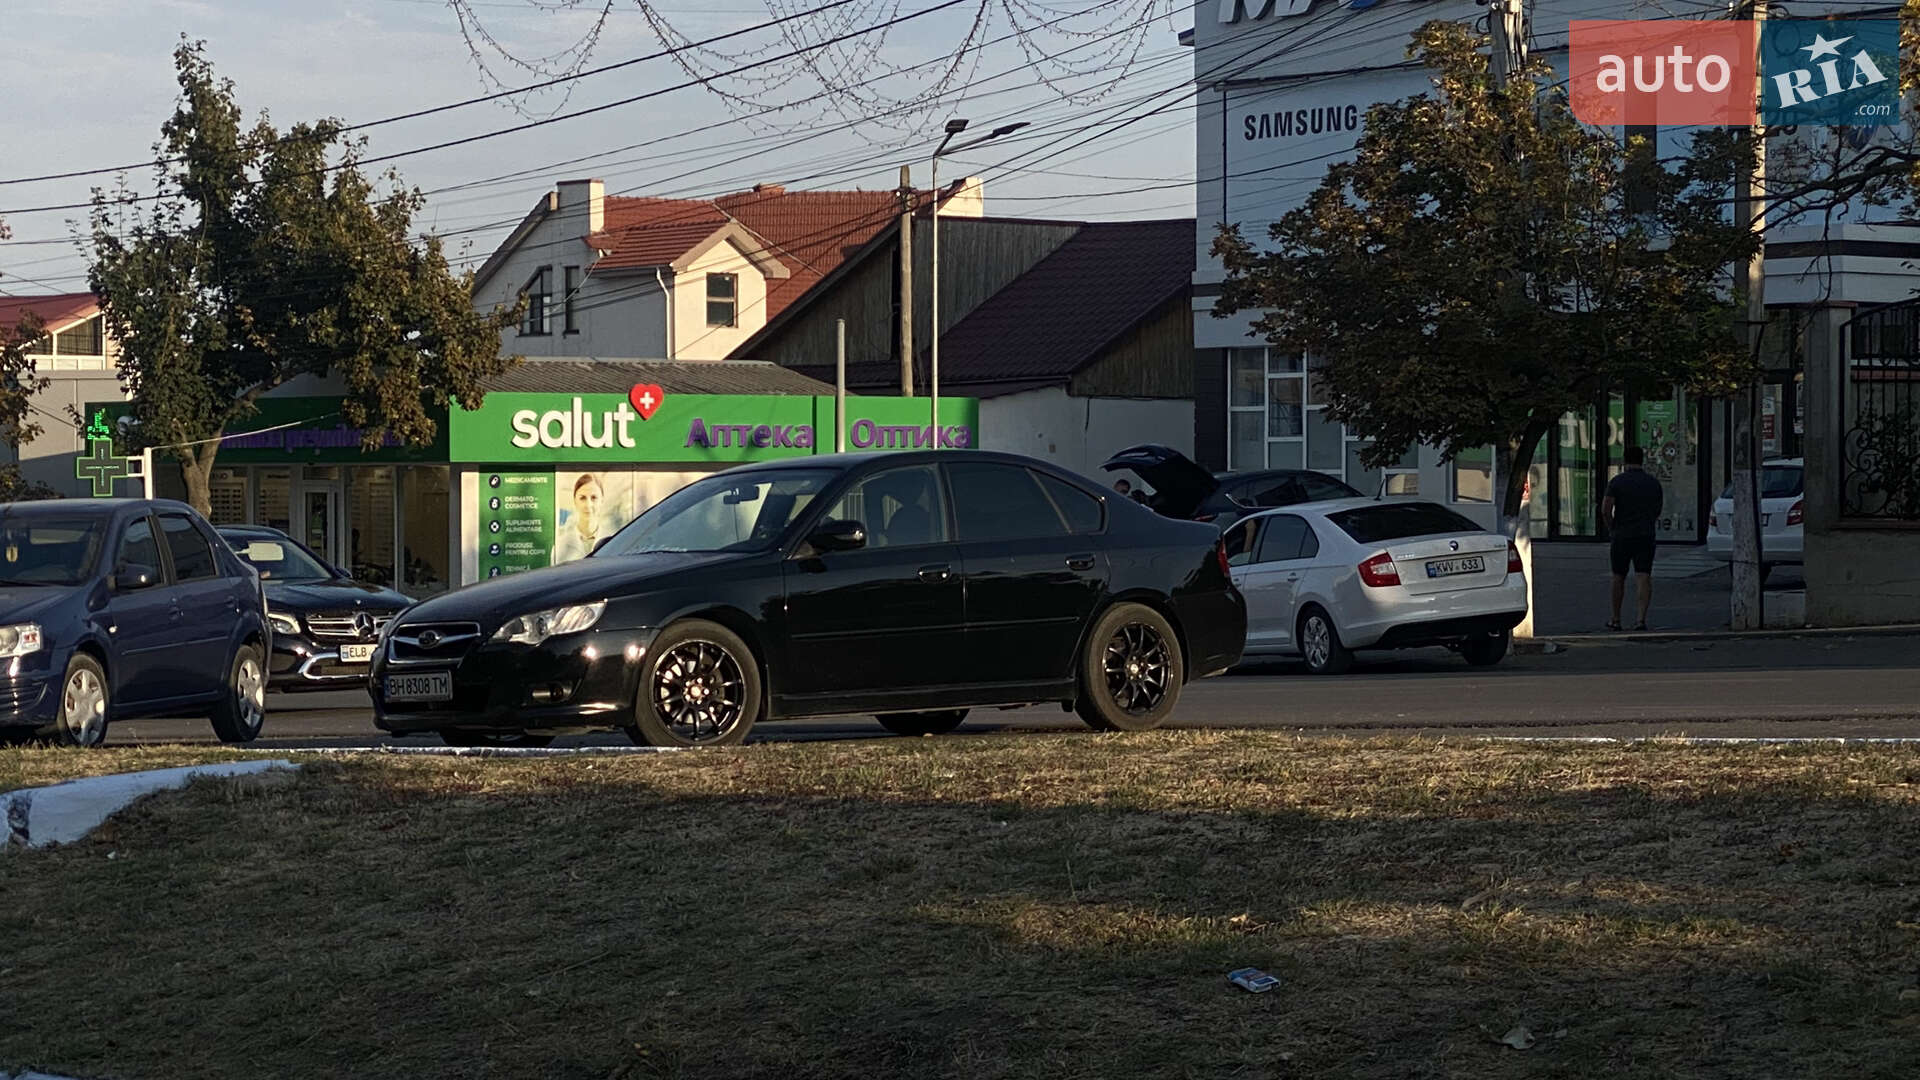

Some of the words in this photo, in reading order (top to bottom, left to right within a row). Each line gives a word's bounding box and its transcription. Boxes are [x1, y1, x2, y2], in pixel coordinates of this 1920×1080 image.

[1244, 104, 1358, 141] SAMSUNG
[511, 396, 636, 449] salut
[685, 417, 814, 449] Аптека
[851, 418, 972, 449] Оптика
[1435, 561, 1454, 573] KWV
[1461, 558, 1479, 570] 633
[349, 647, 367, 658] ELB
